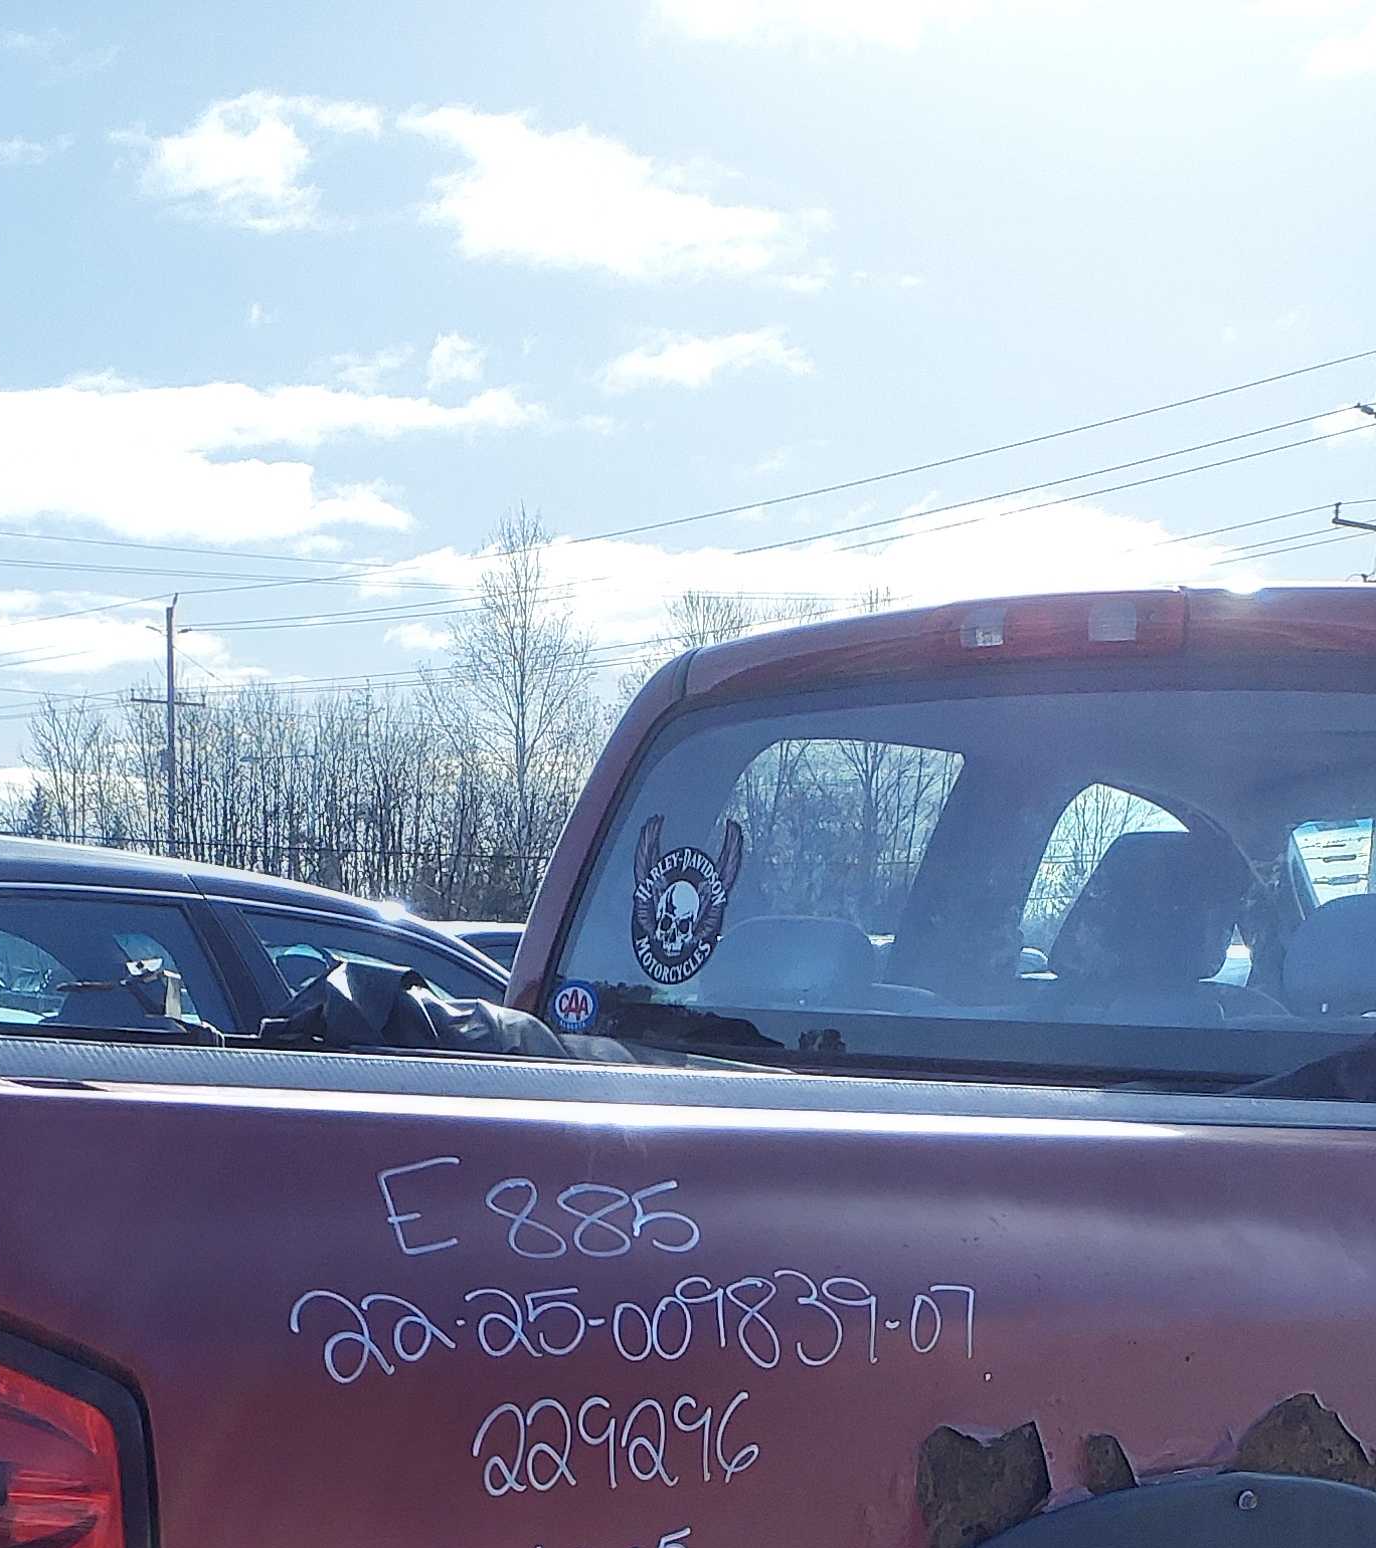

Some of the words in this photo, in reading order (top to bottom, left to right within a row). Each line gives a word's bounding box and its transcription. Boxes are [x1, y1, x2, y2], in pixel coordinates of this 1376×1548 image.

[635, 848, 727, 906] HARLEY-DAVIDSON
[635, 935, 711, 983] MOTORCYCLES
[559, 988, 589, 1021] CAA
[377, 1156, 461, 1255] E
[484, 1176, 702, 1259] 885
[472, 1391, 761, 1498] 229296
